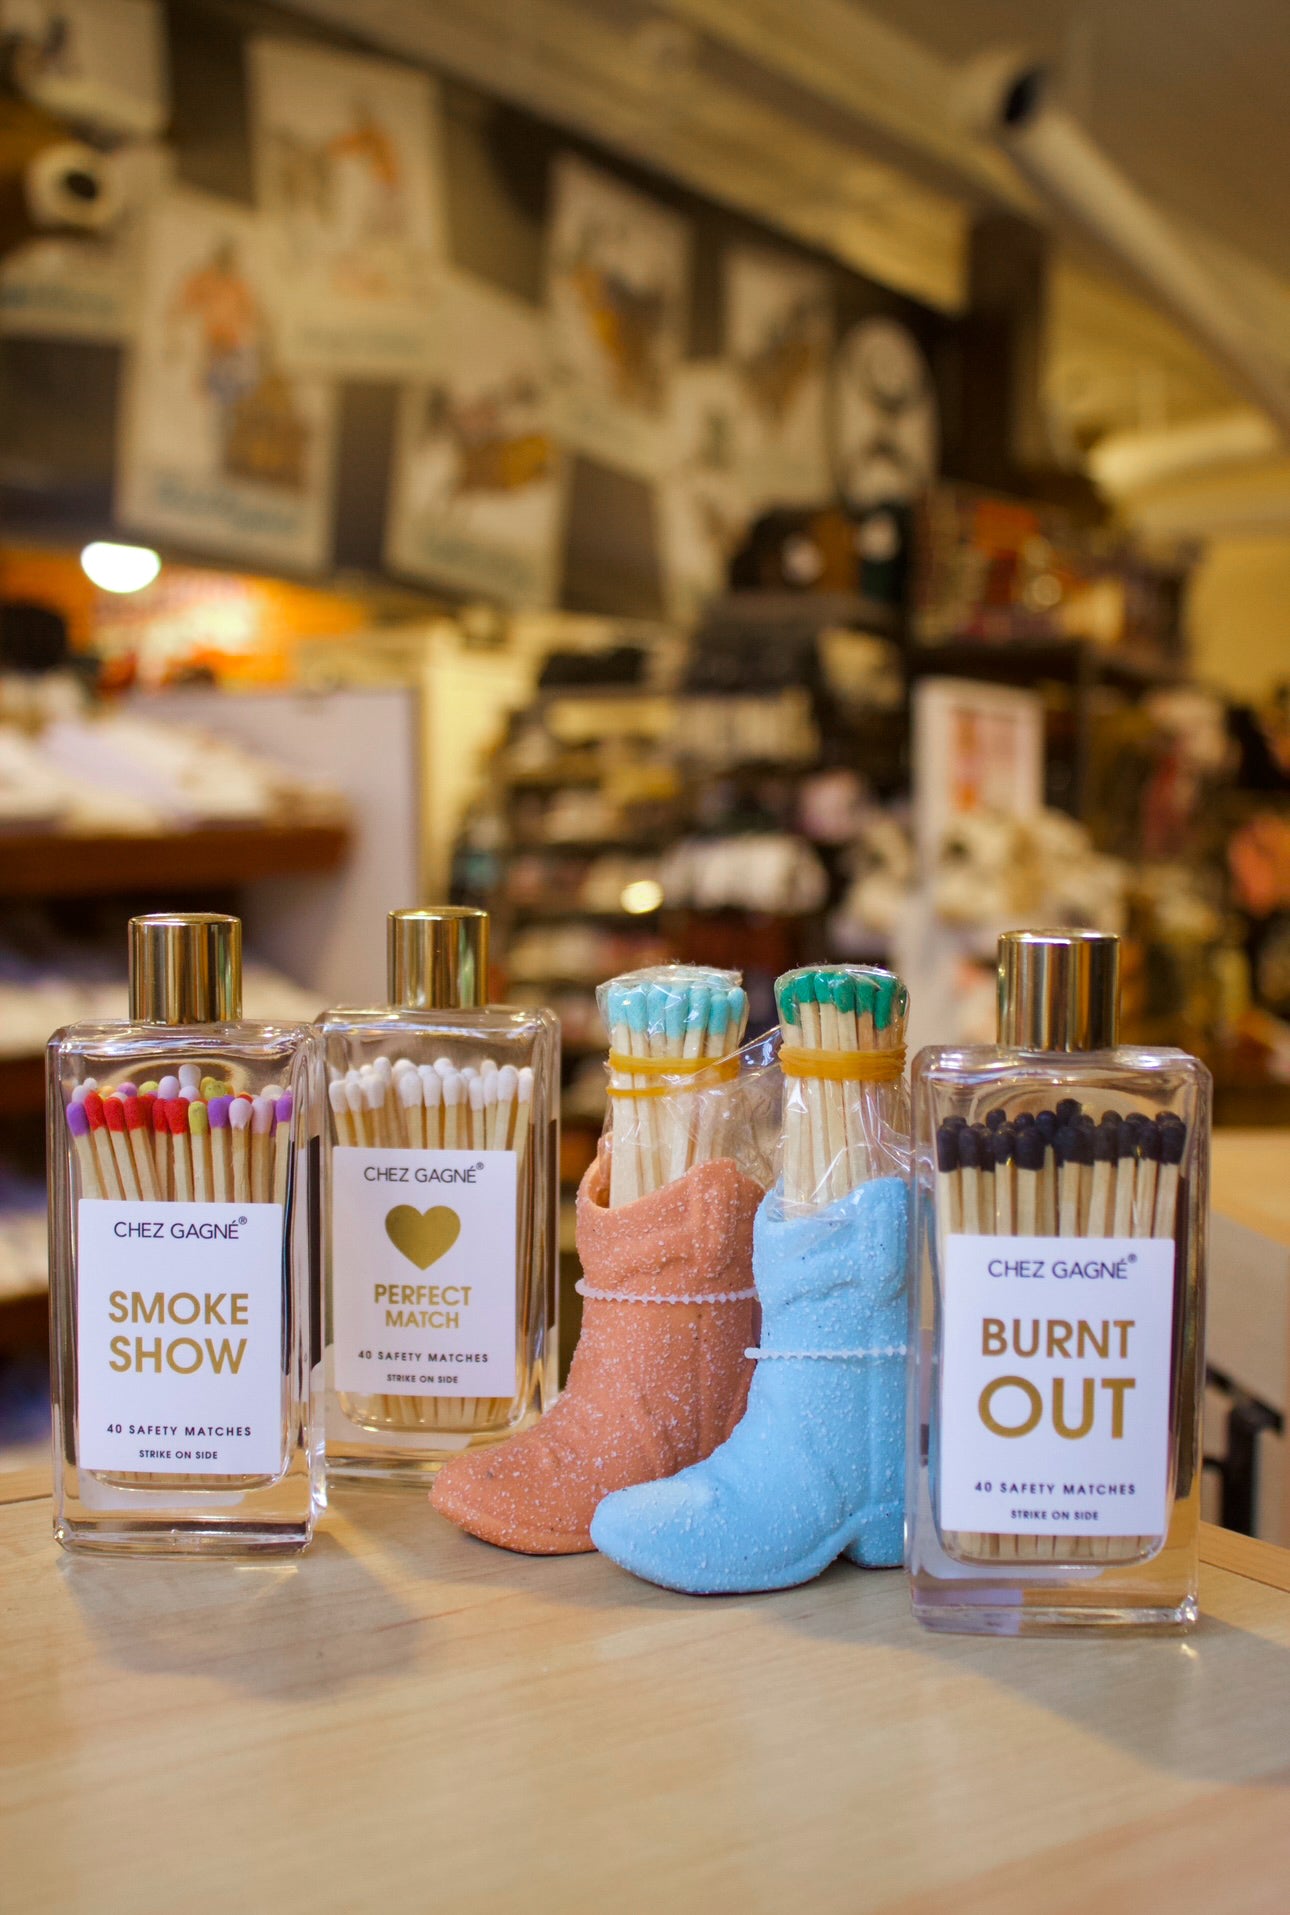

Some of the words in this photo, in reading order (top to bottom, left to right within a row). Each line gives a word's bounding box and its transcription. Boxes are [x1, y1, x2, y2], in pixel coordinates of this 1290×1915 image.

[364, 1167, 409, 1182] CHEZ
[114, 1222, 164, 1238] CHEZ
[988, 1260, 1045, 1278] CHEZ
[374, 1284, 472, 1306] PERFECT
[109, 1290, 248, 1325] SMOKE
[386, 1310, 459, 1328] MATCH
[982, 1318, 1135, 1359] BURNT
[109, 1336, 247, 1374] SHOW
[358, 1351, 372, 1359] 40
[378, 1352, 422, 1362] SAFETY
[428, 1353, 488, 1363] MATCHES
[387, 1374, 416, 1382] STRIKE
[420, 1375, 434, 1383] ON
[438, 1375, 458, 1384] SIDE
[978, 1376, 1136, 1440] OUT
[107, 1424, 122, 1434] 40
[129, 1425, 177, 1436] SAFETY
[185, 1426, 252, 1436] MATCHES
[139, 1450, 171, 1459] STRIKE
[176, 1451, 191, 1459] ON
[196, 1451, 217, 1459] SIDE
[975, 1482, 992, 1492] 40
[1000, 1483, 1054, 1494] SAFETY
[1063, 1484, 1136, 1495] MATCHES
[1011, 1510, 1047, 1520] STRIKE
[1052, 1510, 1069, 1520] ON
[1074, 1511, 1098, 1520] SIDE
